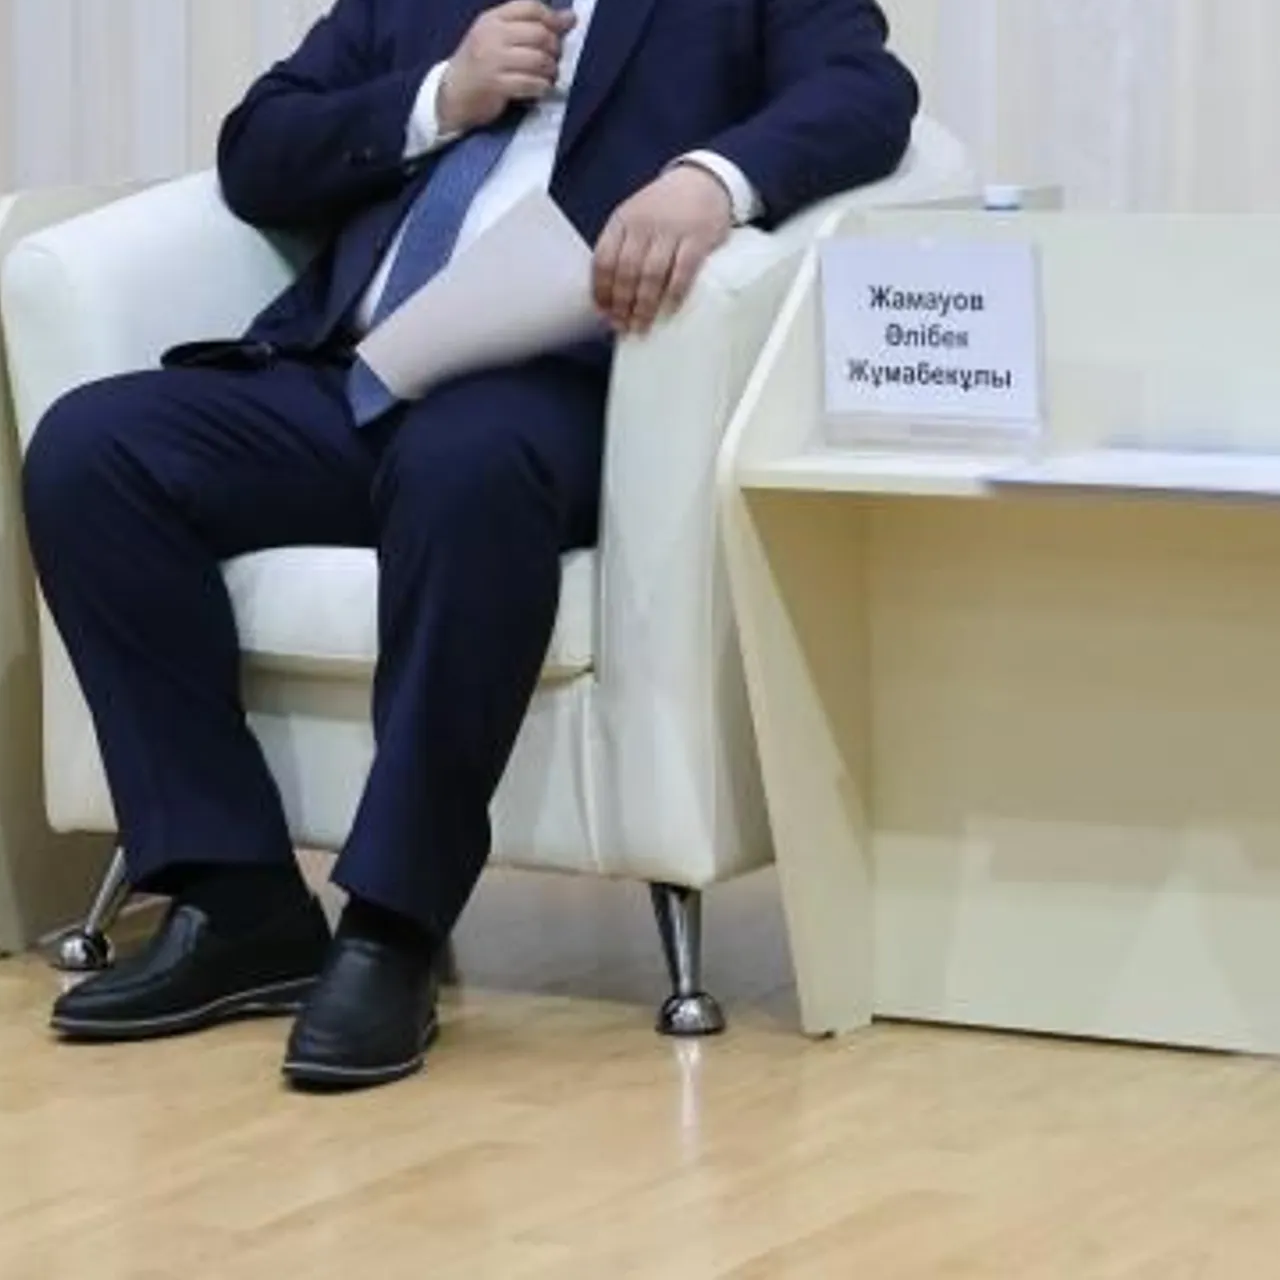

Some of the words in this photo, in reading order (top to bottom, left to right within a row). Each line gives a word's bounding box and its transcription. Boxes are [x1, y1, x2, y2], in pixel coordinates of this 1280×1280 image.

[868, 285, 985, 317] Жамауов
[885, 323, 969, 347] Әлібек
[847, 358, 1012, 392] Жұмабекұлы
